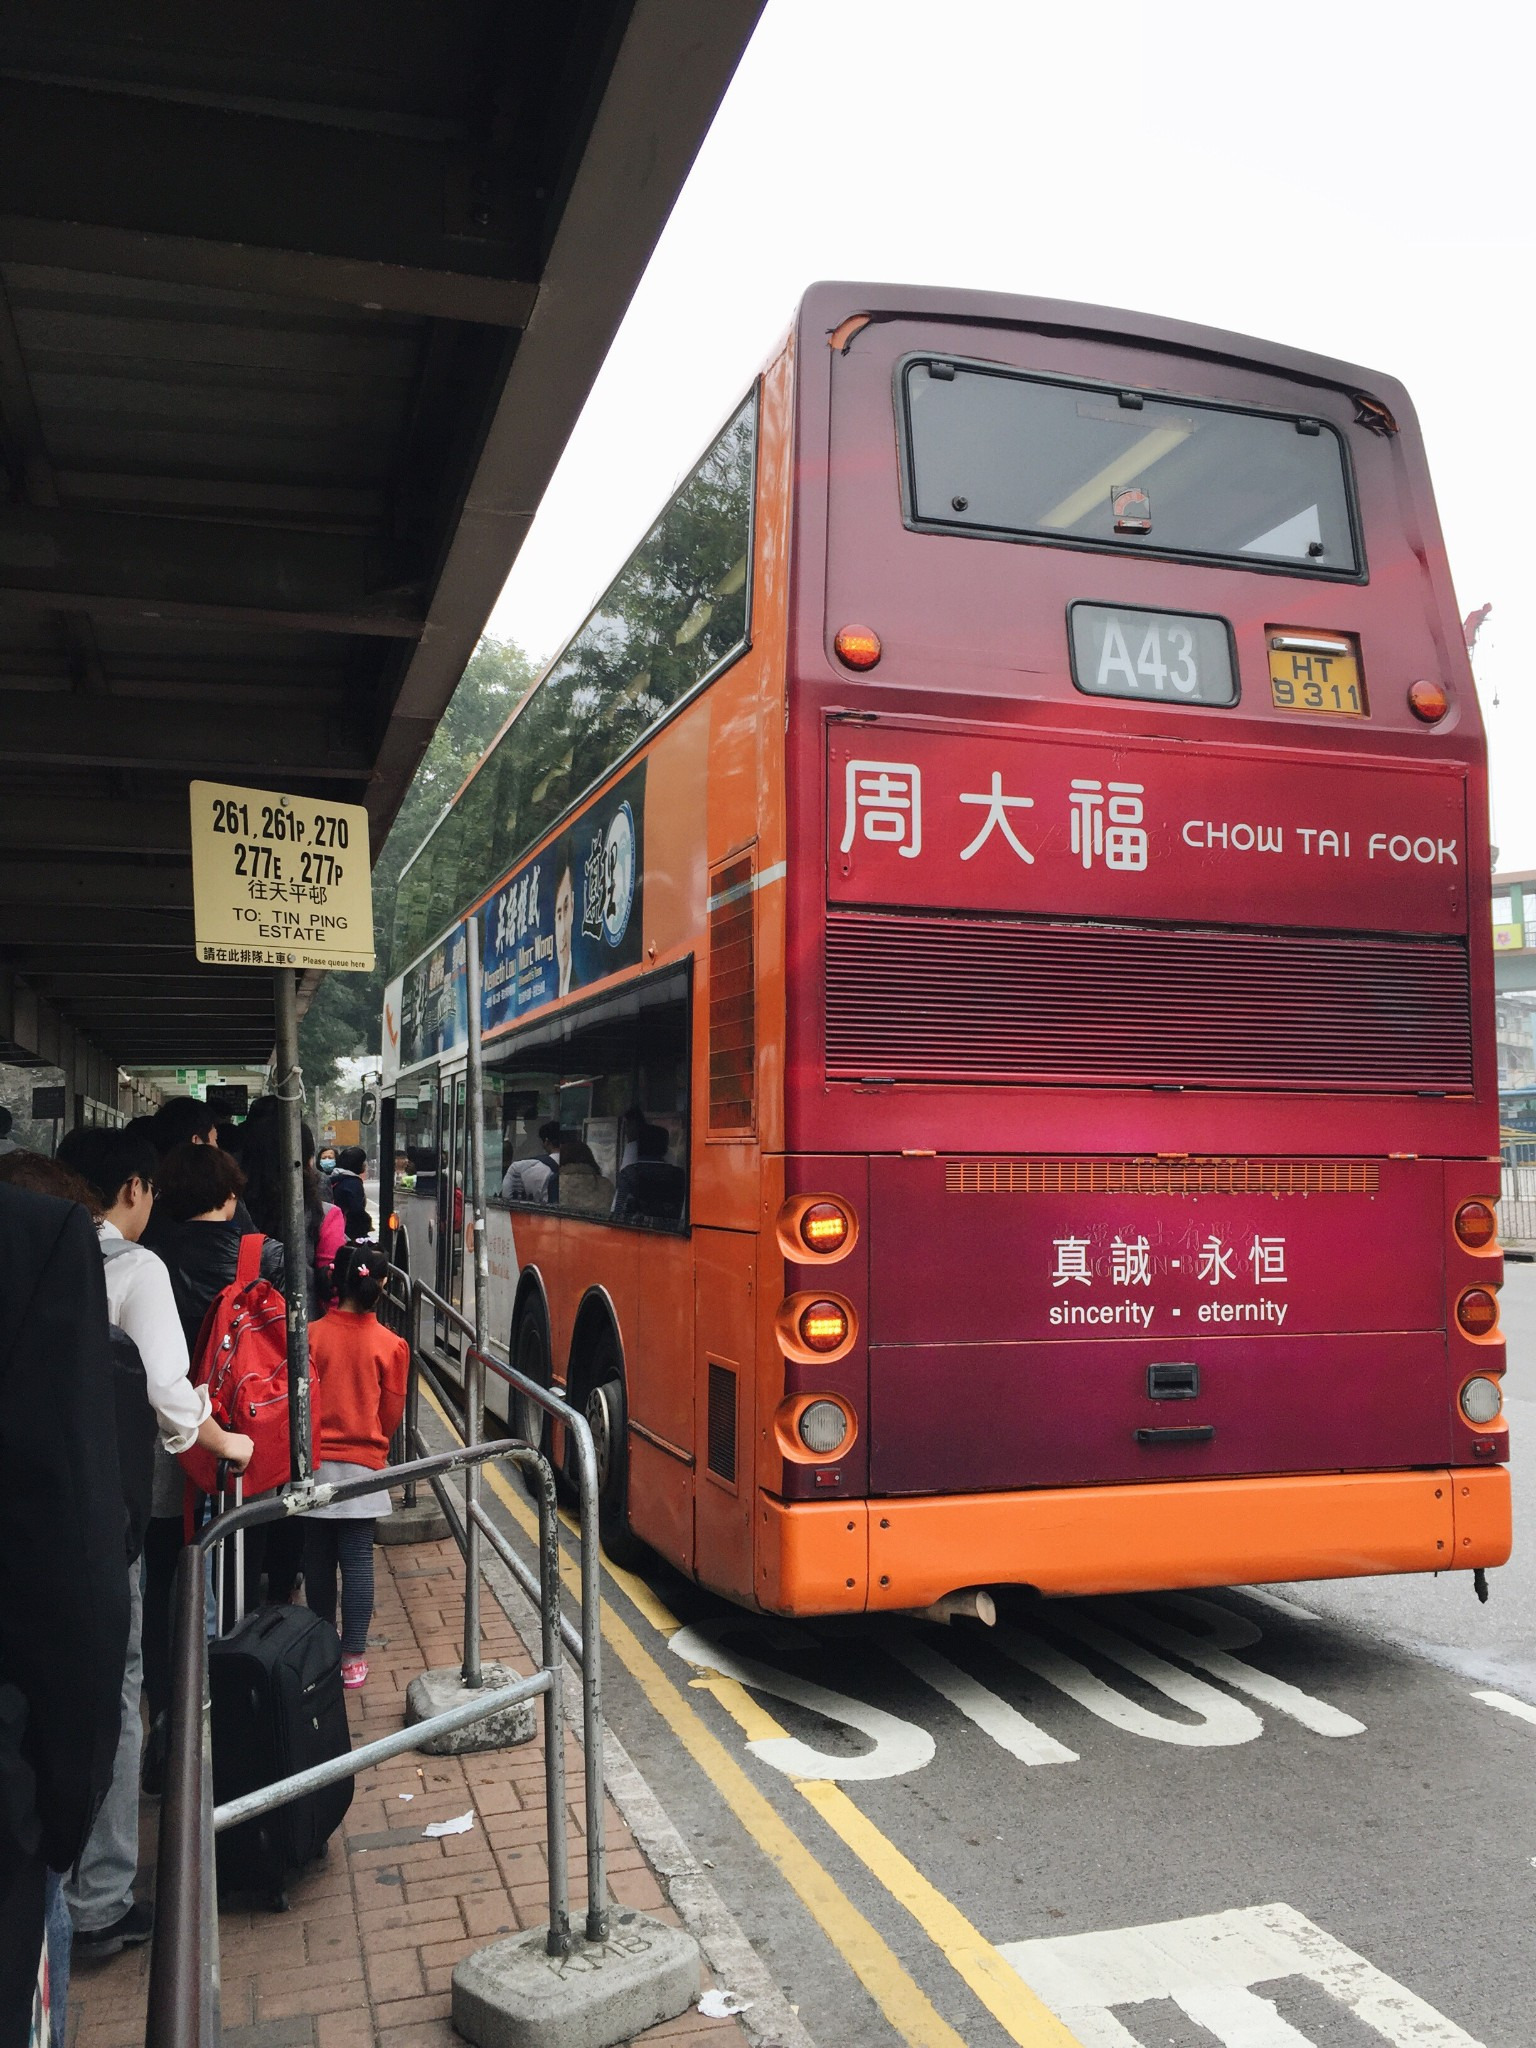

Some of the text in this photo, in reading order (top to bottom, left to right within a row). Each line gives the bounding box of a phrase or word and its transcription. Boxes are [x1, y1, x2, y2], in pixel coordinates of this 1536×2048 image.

[1096, 617, 1198, 695] A43
[1292, 655, 1334, 683] HT
[1273, 680, 1360, 713] 9311
[840, 759, 1148, 872] 周大福
[314, 815, 349, 849] 270
[1182, 820, 1459, 866] CHOW TAI FOOK
[300, 852, 344, 887] 277P
[247, 880, 328, 906] 往天平邨
[232, 907, 348, 930] TO: TIN PING
[259, 924, 326, 942] ESTATE
[203, 946, 287, 965] 請在此排隊上車
[302, 956, 366, 969] Please queue here
[1049, 1298, 1289, 1329] sincerity eternity
[546, 1936, 653, 1981] KMB
